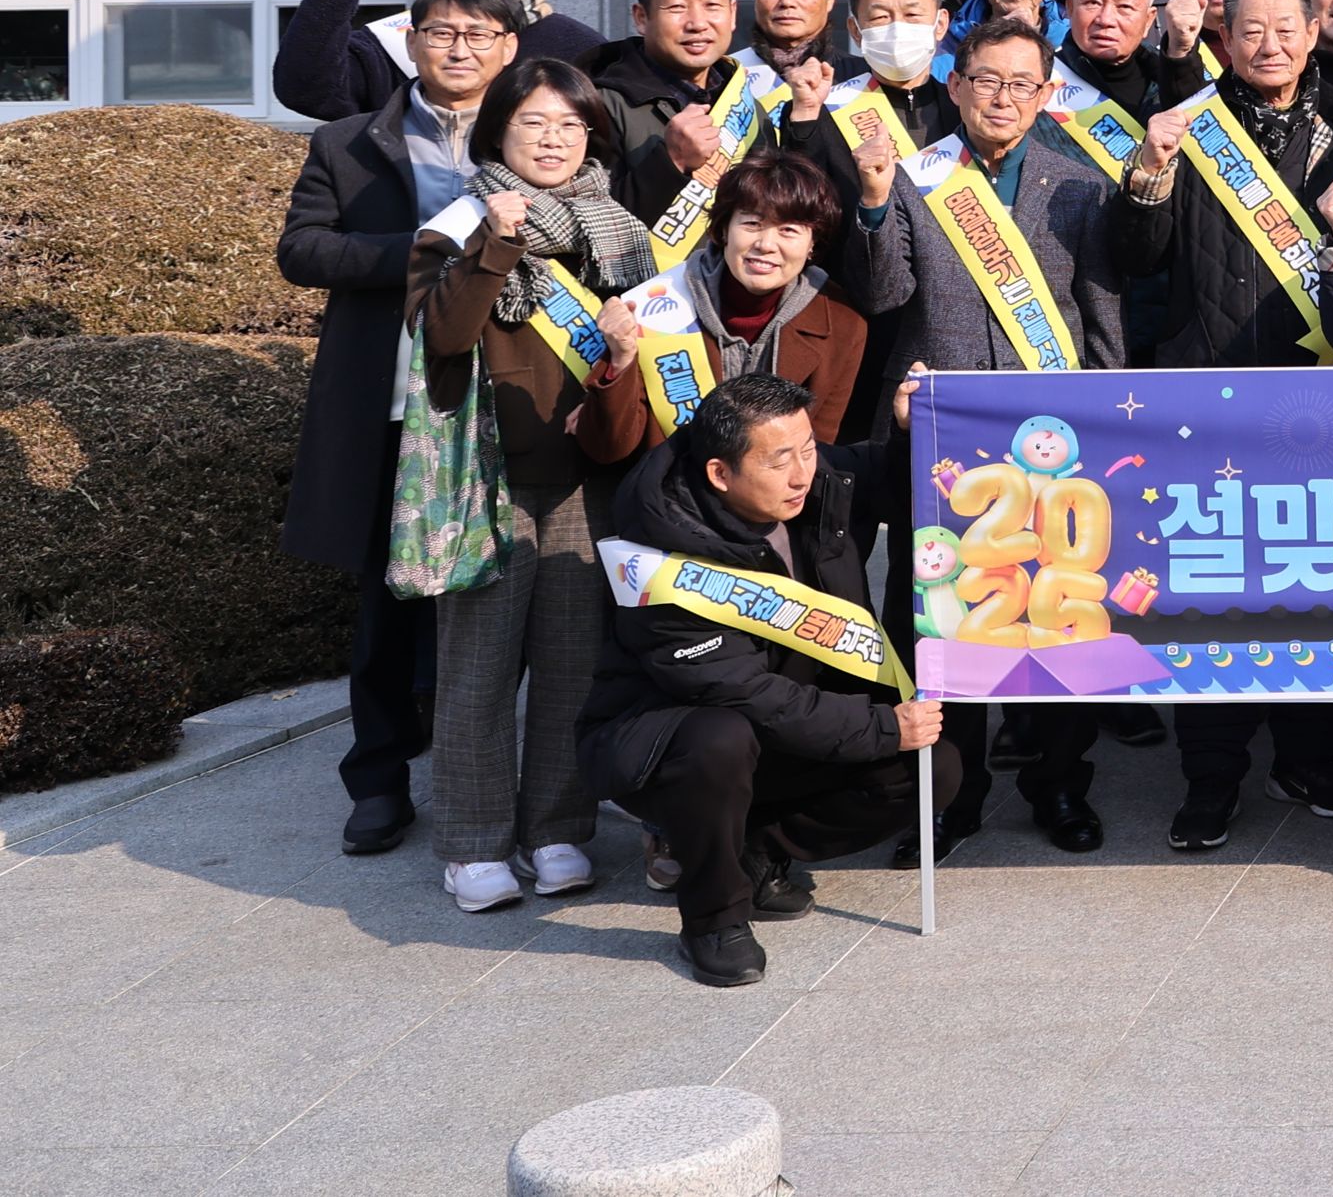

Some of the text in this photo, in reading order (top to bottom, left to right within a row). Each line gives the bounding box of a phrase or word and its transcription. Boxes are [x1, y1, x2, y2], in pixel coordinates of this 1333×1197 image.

[1189, 108, 1272, 210] 전통시장을
[944, 186, 1034, 306] 명절장보기는
[673, 559, 886, 666] 전통시장을 애용합시다
